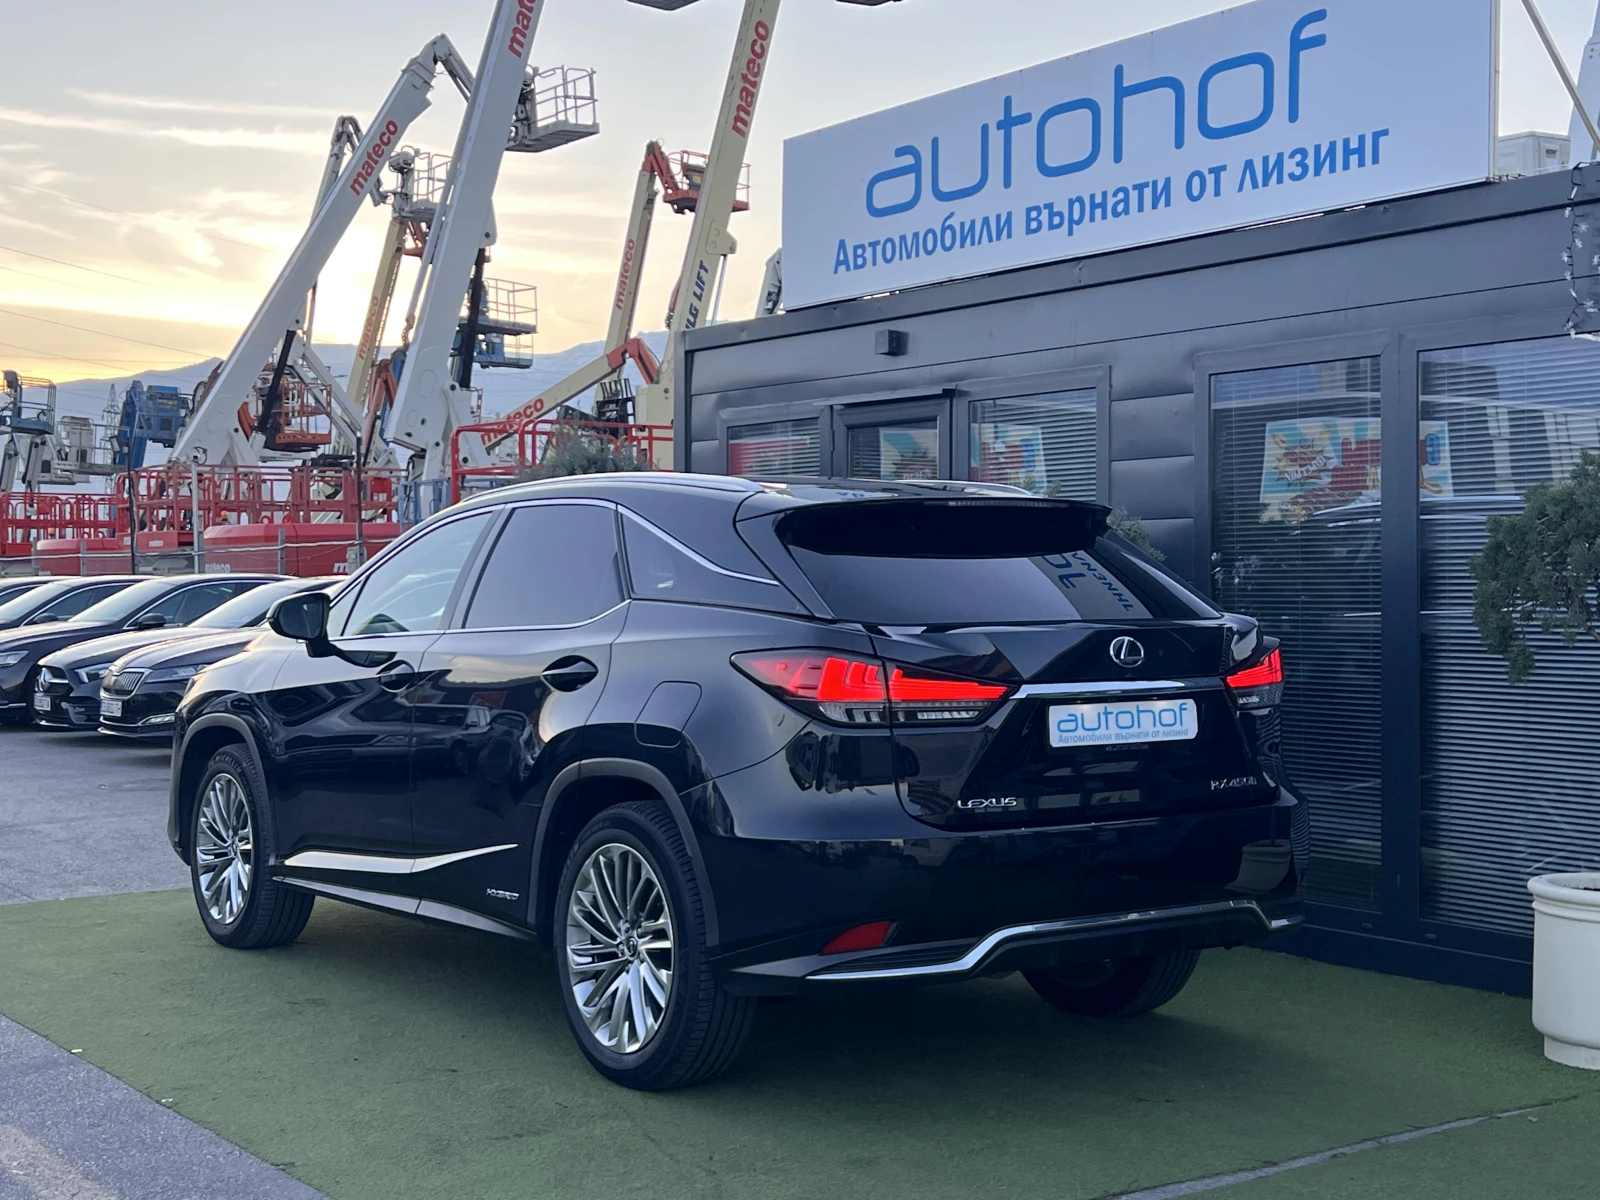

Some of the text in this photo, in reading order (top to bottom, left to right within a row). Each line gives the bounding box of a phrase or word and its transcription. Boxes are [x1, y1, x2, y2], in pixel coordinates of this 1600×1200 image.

[731, 20, 770, 138] mateco
[866, 8, 1328, 218] autohof
[350, 120, 398, 196] mateco
[833, 128, 1390, 275] Автомобили върнати от лизинг
[615, 238, 635, 310] mateco
[692, 259, 709, 302] LIFT
[1057, 702, 1188, 733] autohof
[1057, 728, 1190, 744] Автомобили върнати от лизинг
[957, 796, 1017, 809] LEXUS
[1210, 779, 1227, 791] RX
